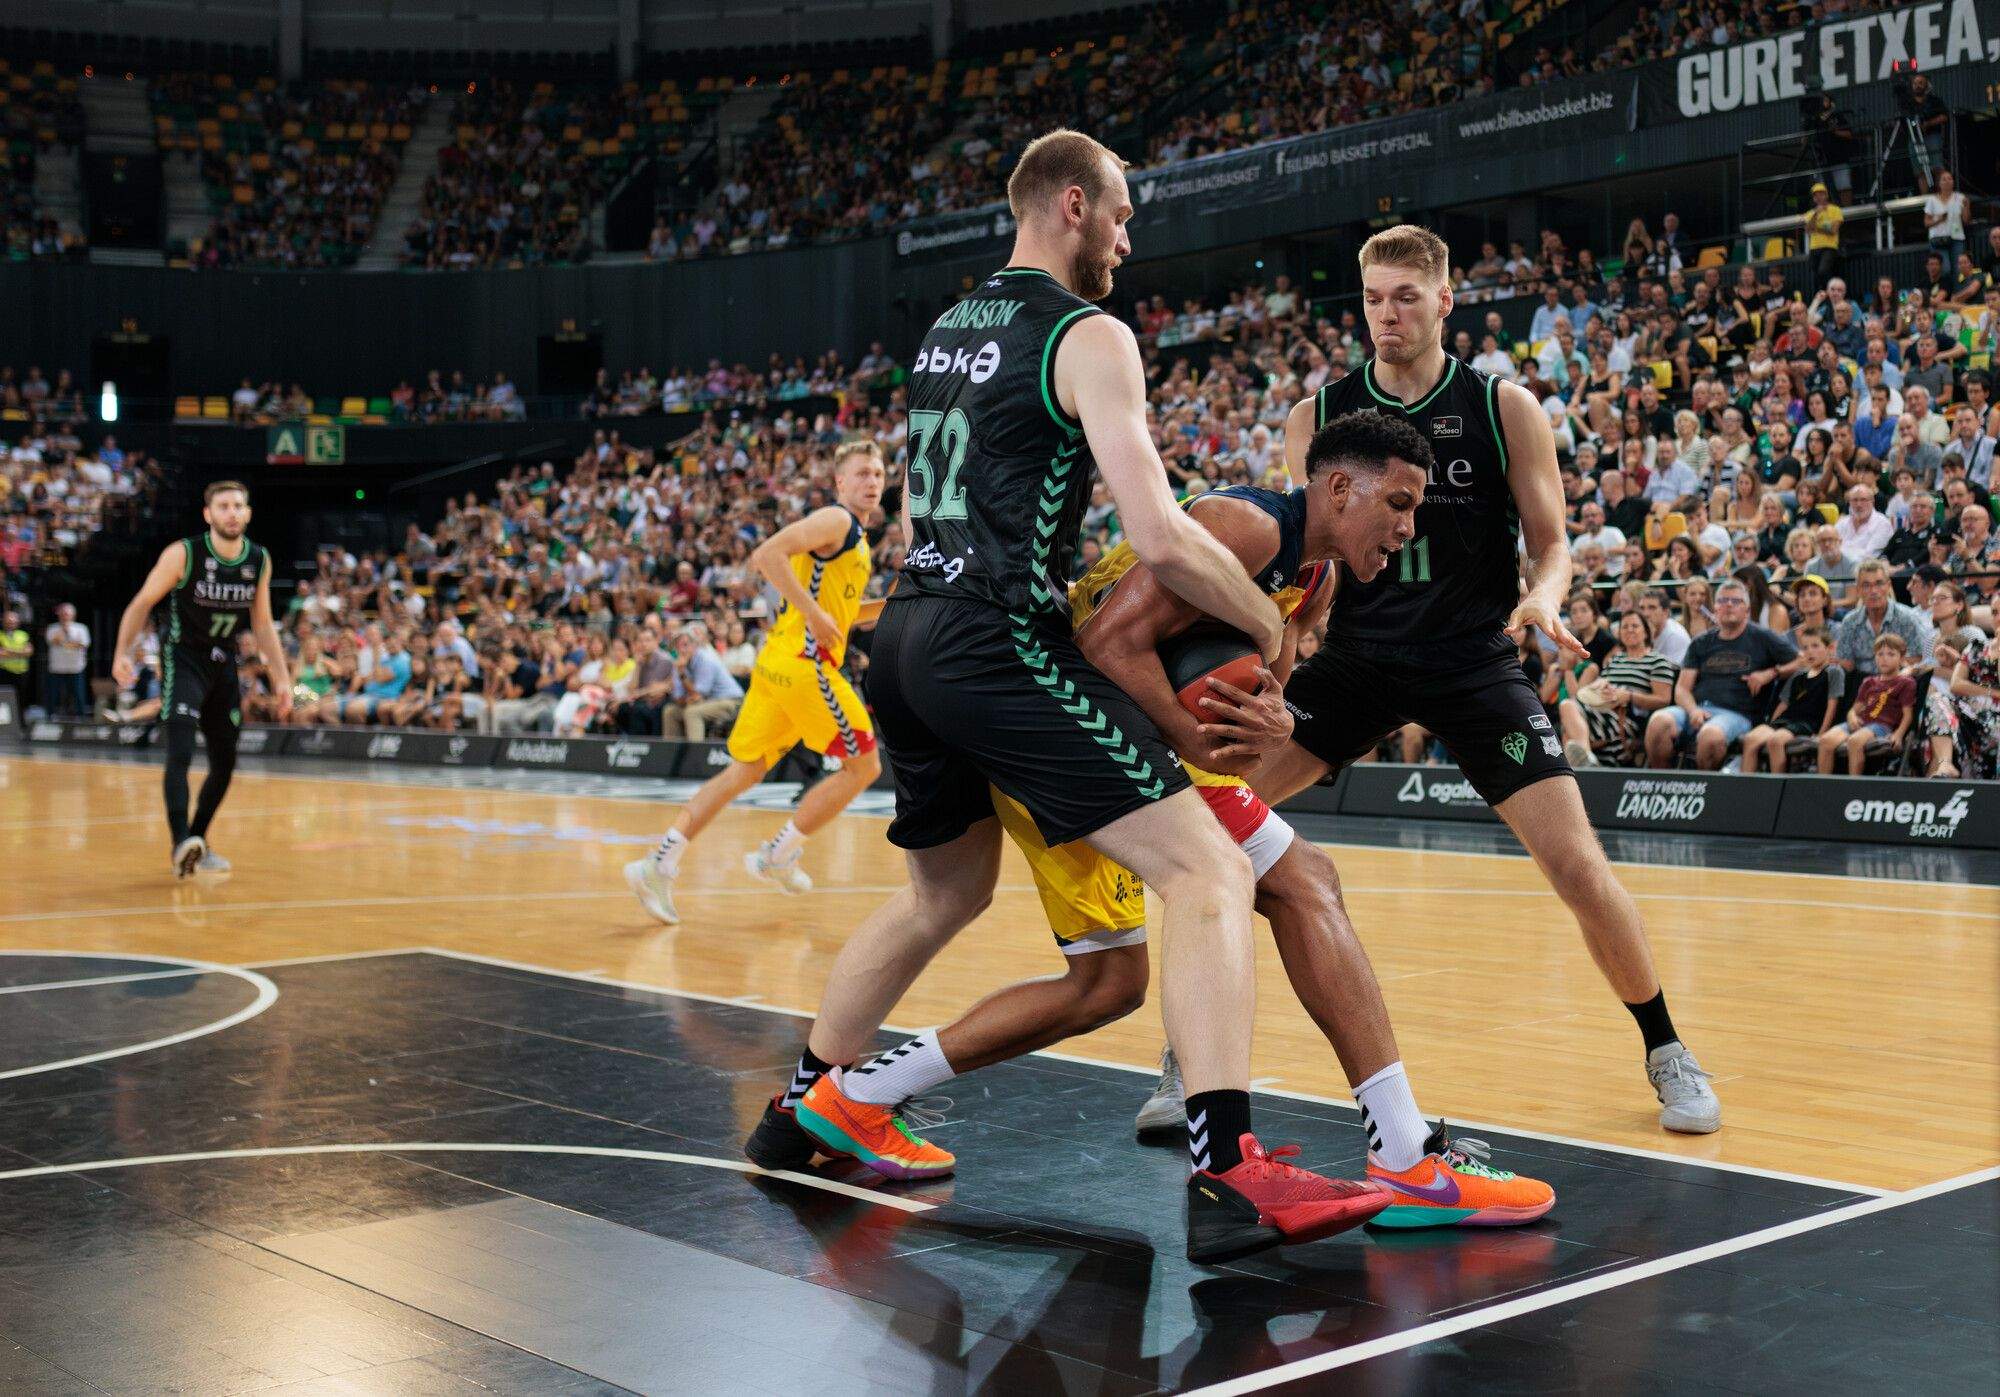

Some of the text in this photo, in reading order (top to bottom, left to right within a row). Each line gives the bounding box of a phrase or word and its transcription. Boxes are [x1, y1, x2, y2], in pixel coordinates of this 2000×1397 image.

[1677, 31, 1806, 118] GURE
[1458, 90, 1614, 138] www.bilbaobasket.biz
[1330, 141, 1378, 165] BASKET
[275, 428, 298, 456] A
[908, 407, 970, 520] 32
[1399, 535, 1432, 582] 11
[209, 613, 239, 638] 77
[1616, 793, 1706, 820] LANDAKO
[1909, 823, 1957, 839] SPORT
